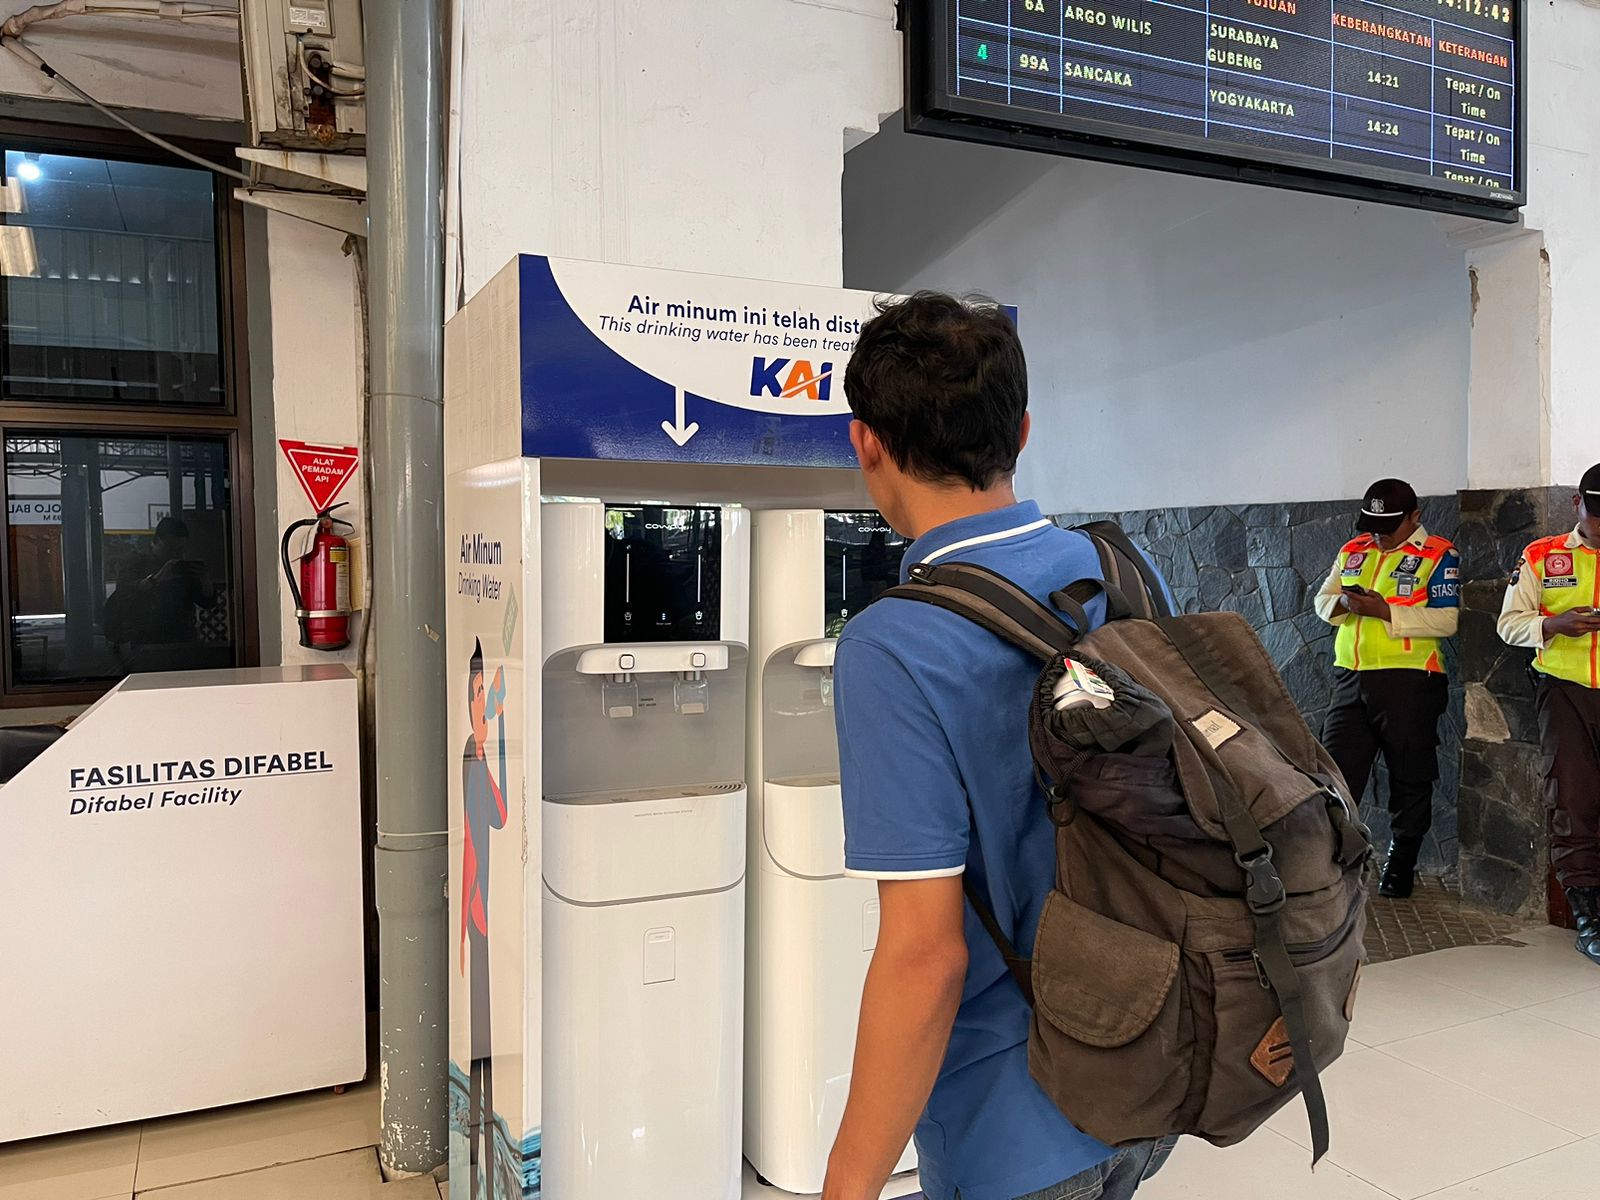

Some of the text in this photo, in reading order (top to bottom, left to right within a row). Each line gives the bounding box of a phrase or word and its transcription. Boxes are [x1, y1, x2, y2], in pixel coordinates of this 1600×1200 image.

[1025, 0, 1045, 13] 6A
[1064, 5, 1152, 35] ARGO WILIS
[1332, 13, 1432, 48] KEBERANGKATAN
[1210, 23, 1279, 50] SURABAYA
[977, 43, 989, 60] 4
[1019, 53, 1049, 72] 99A
[1208, 48, 1262, 71] GUBENG
[1438, 40, 1508, 68] KETERANGAN
[1064, 62, 1133, 87] SANCAKA
[1367, 71, 1399, 88] 14:21
[1445, 77, 1501, 101] Tepat / On
[1209, 89, 1295, 117] YOGYAKARTA
[1461, 103, 1486, 119] Time
[1367, 120, 1399, 136] 14:24
[1445, 124, 1500, 146] Tepat / On
[1460, 149, 1486, 165] Time
[628, 295, 660, 315] Air
[666, 300, 737, 323] minum
[744, 305, 766, 326] ini
[773, 311, 820, 331] telah
[599, 315, 632, 333] This
[636, 319, 701, 342] drinking
[706, 328, 749, 343] water
[753, 330, 779, 346] has
[783, 332, 818, 349] been
[750, 356, 833, 401] KAI
[301, 464, 344, 476] PEMADAM
[313, 457, 335, 466] ALAT
[314, 475, 329, 483] API
[645, 523, 685, 532] coway
[858, 526, 892, 534] coway
[460, 532, 502, 565] Air Minum
[458, 571, 502, 603] Drinking Water
[69, 750, 333, 789] FASILITAS DIFABEL
[69, 785, 243, 816] Difabel Facility
